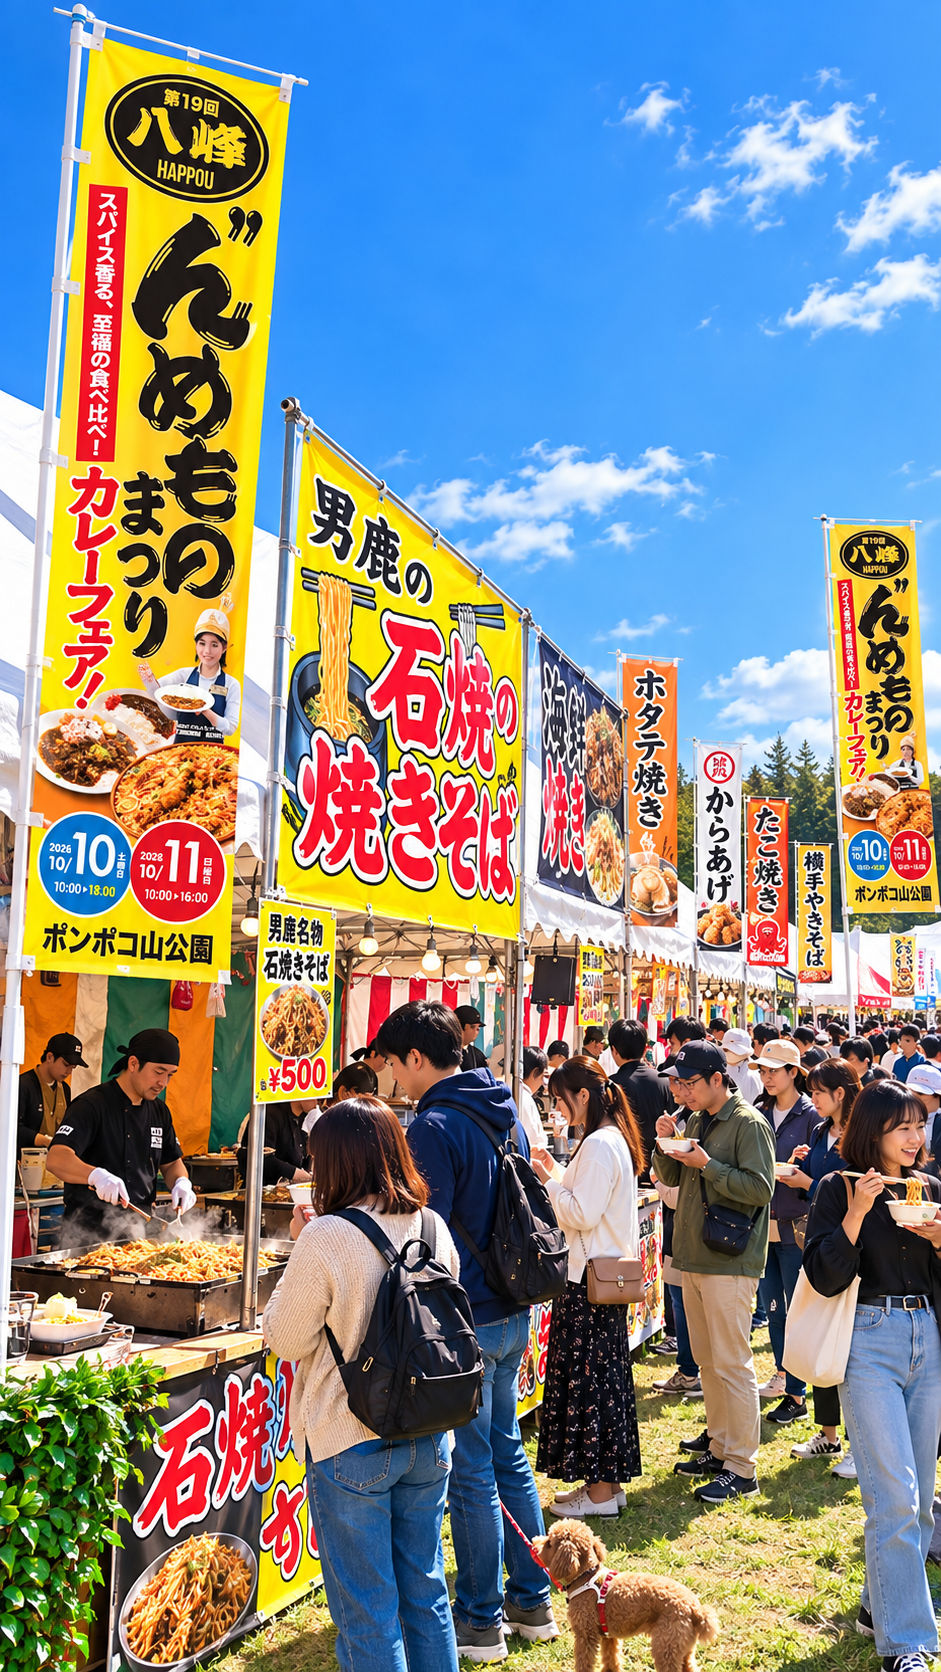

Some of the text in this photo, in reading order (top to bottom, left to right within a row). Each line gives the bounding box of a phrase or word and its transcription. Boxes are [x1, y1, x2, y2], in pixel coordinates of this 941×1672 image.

[126, 105, 248, 170] 八峰
[163, 87, 220, 119] 第19回
[156, 158, 215, 191] HAPPOU
[116, 470, 169, 659] まつり
[308, 474, 433, 604] 男鹿の
[367, 611, 518, 777] 石焼の
[864, 689, 889, 761] まつり
[632, 669, 668, 828] ホタテ焼き
[295, 734, 519, 903] 焼きそば
[705, 785, 735, 904] からあげ
[753, 806, 784, 914] たこ焼き
[42, 922, 214, 965] ポンポコ山公園
[268, 912, 323, 947] 男鹿名物
[803, 850, 826, 968] 横手やきそば
[263, 948, 330, 982] 石焼きそば
[268, 1058, 327, 1092] ¥500
